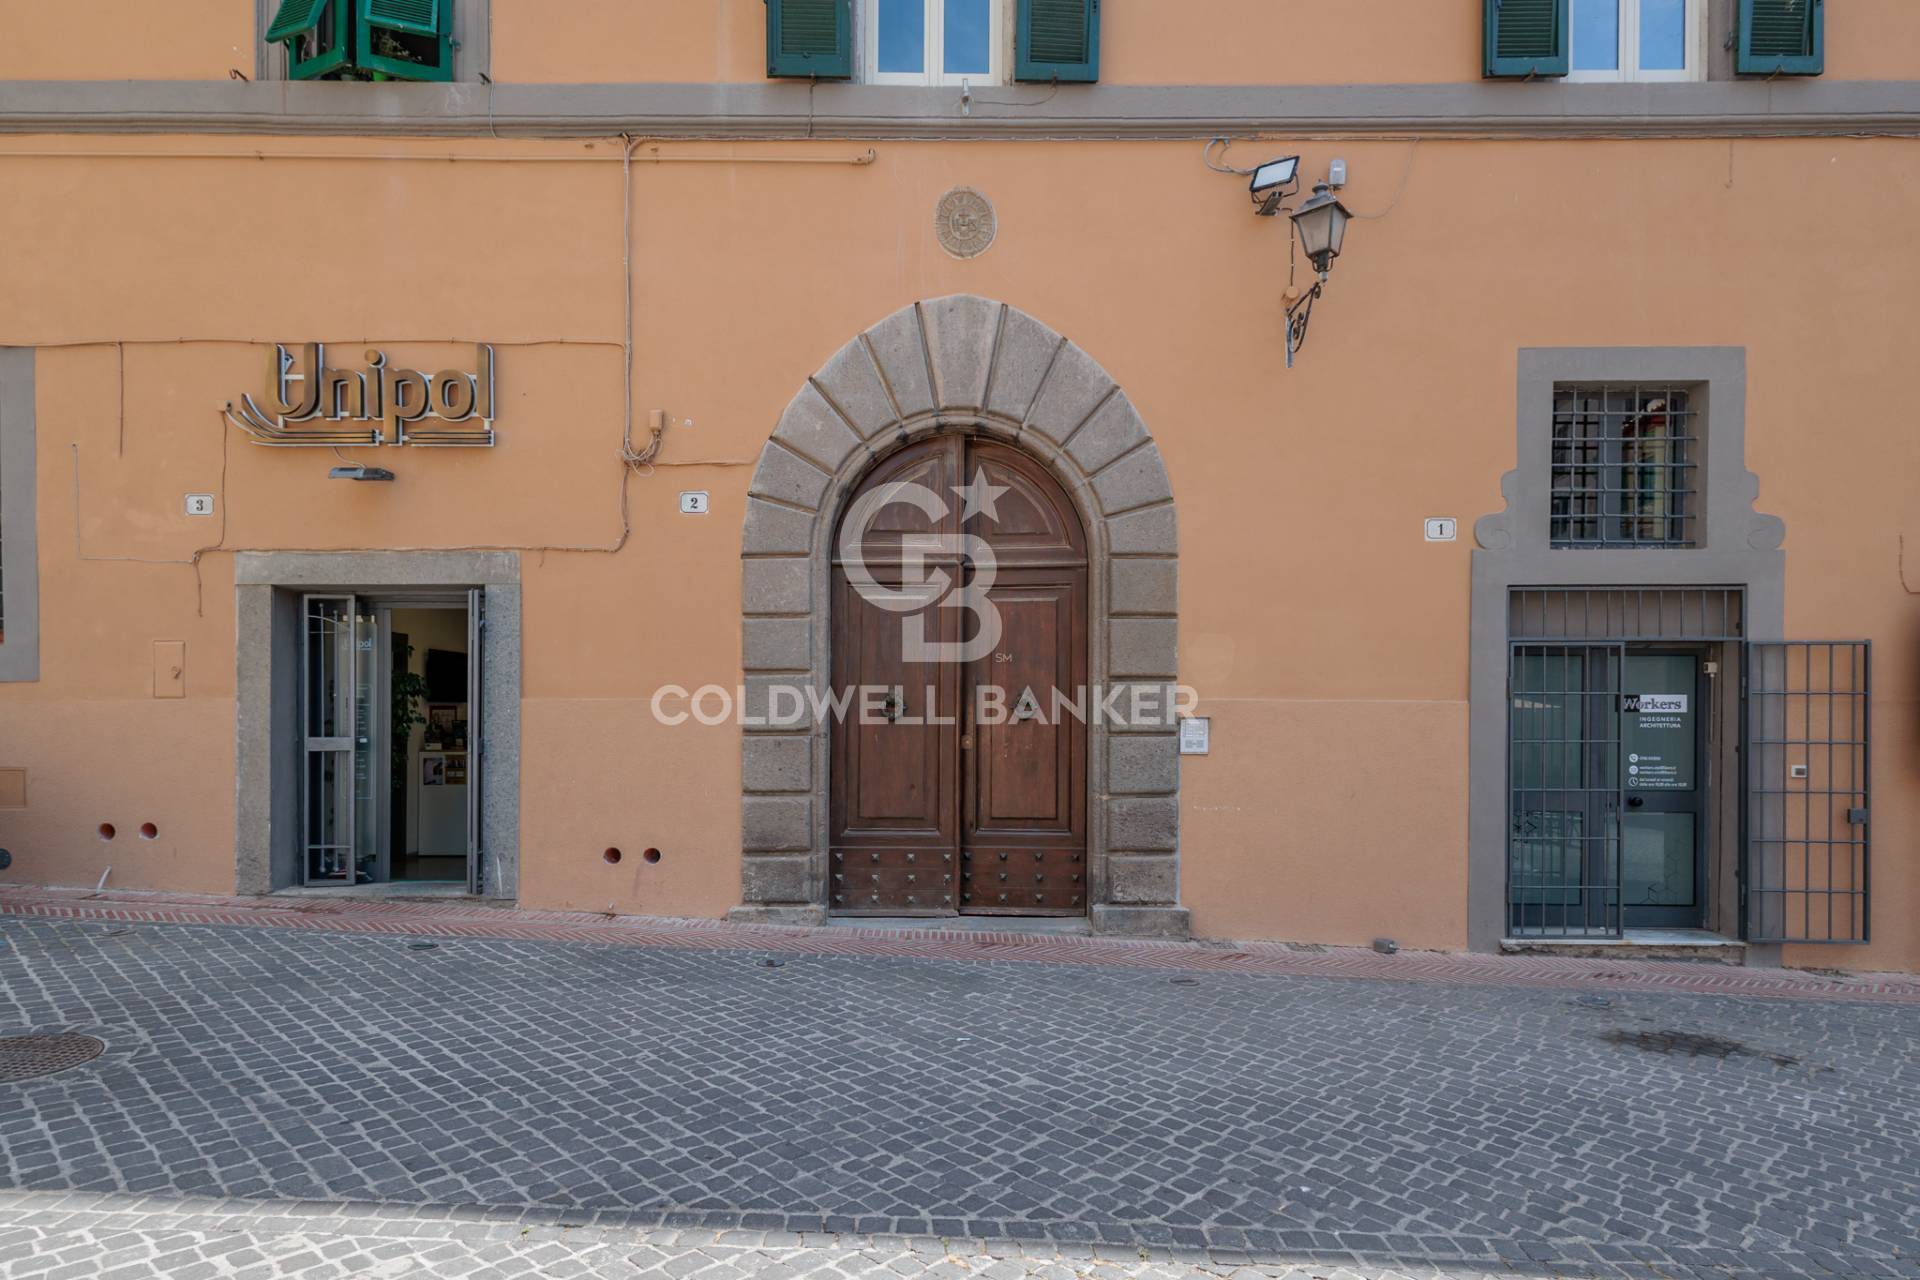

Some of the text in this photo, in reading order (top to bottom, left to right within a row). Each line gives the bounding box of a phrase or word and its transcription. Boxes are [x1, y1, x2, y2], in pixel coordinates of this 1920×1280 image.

[265, 342, 495, 446] Unipol
[195, 499, 204, 512] 3
[690, 496, 698, 509] 2
[1437, 523, 1443, 536] 1
[1623, 697, 1682, 710] Workers
